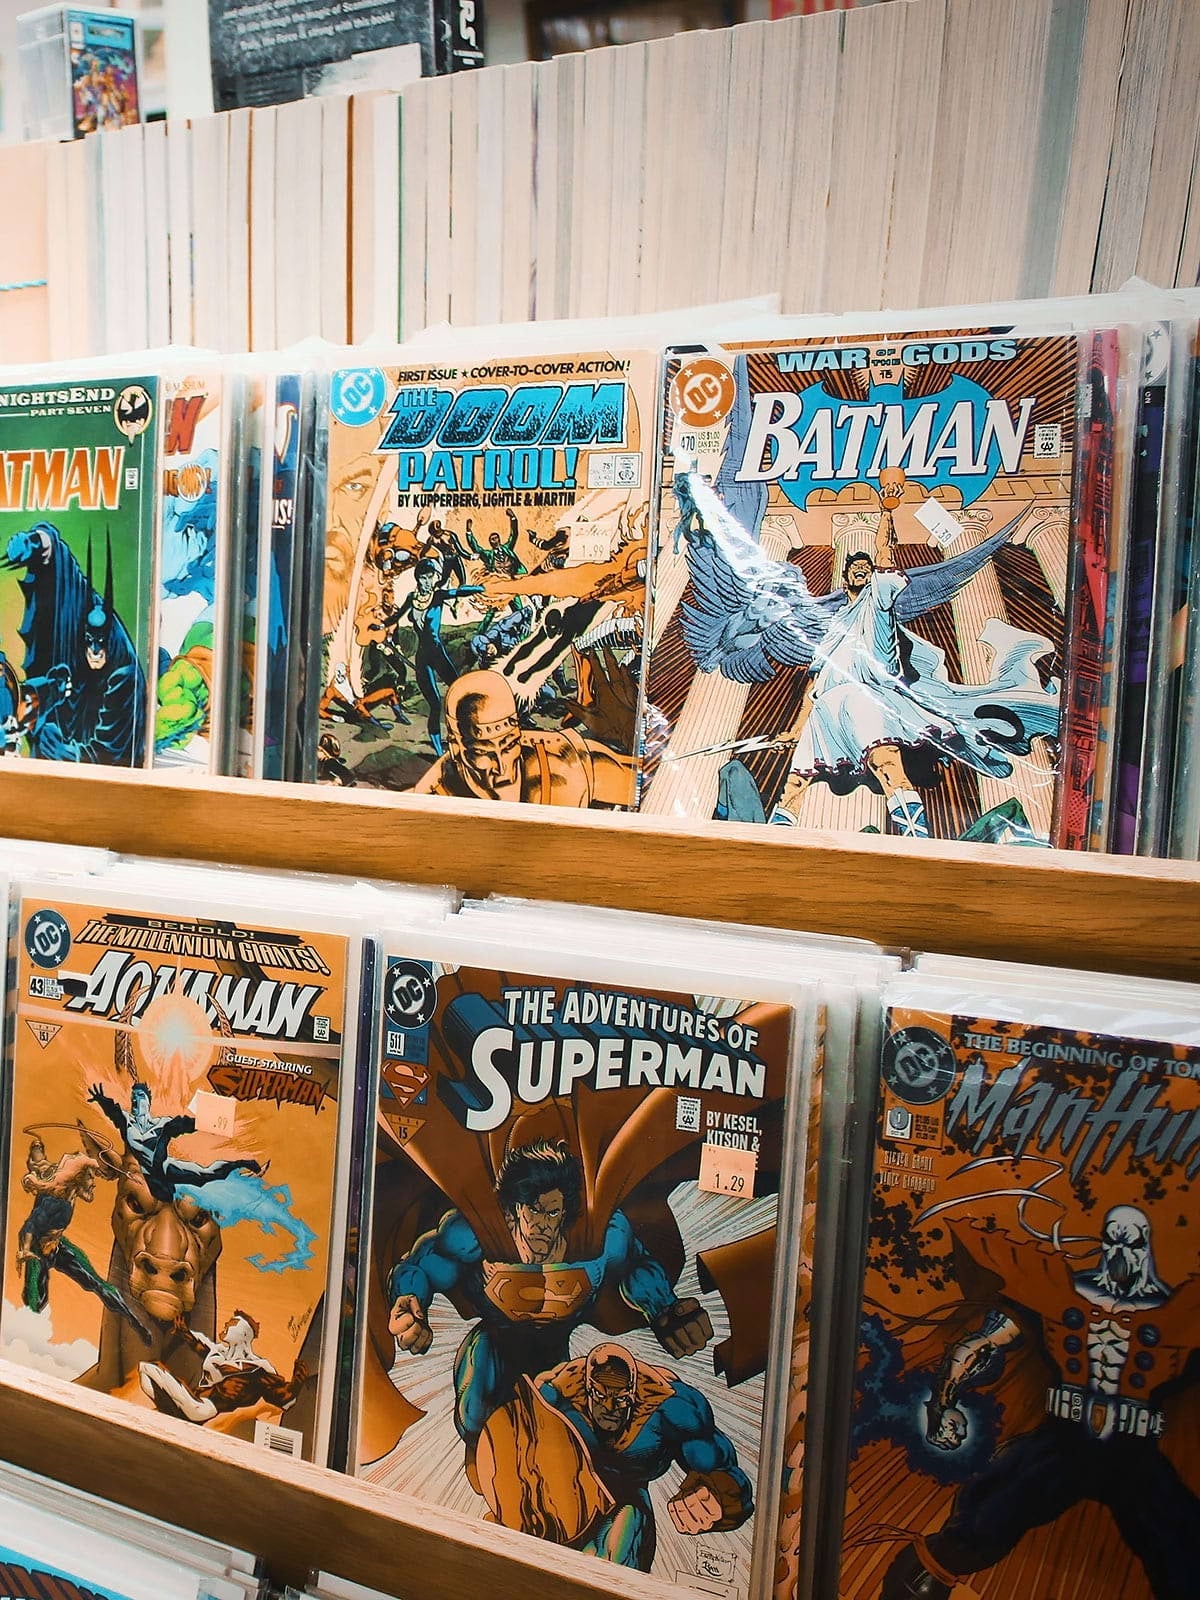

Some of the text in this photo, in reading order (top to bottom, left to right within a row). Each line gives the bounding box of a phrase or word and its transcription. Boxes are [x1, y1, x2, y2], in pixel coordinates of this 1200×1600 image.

[777, 340, 1019, 373] WAR OF THE GODS
[398, 360, 631, 382] FIRST ISSUE COVER-TO-COVER ACTION!
[400, 387, 439, 409] THE
[686, 376, 721, 410] DC
[29, 404, 112, 418] PART SEVEN
[378, 381, 627, 451] DOOM
[735, 391, 1038, 483] BATMAN
[397, 447, 580, 492] PATROL!
[397, 492, 577, 509] BY KUPPERBERG, LIGHTLE & MARTIN
[147, 919, 256, 940] BEHOLD!
[74, 920, 331, 977] THE MILLENNIUM GIANTS!
[30, 978, 44, 995] 43
[395, 980, 423, 1010] DC
[503, 988, 760, 1054] THE ADVENTURES OF
[389, 1032, 402, 1050] 511
[965, 1033, 1002, 1052] THE
[1006, 1038, 1124, 1069] BEGINNING
[1129, 1054, 1161, 1072] OF
[226, 1053, 313, 1075] GUEST-STARRING
[207, 1064, 331, 1116] SUPERMAN
[464, 1026, 767, 1133] SUPERMAN
[399, 1126, 408, 1140] 15
[706, 1110, 721, 1128] BY
[723, 1112, 763, 1137] KESEL,
[706, 1128, 761, 1153] KITSON &
[714, 1172, 745, 1193] 1.29
